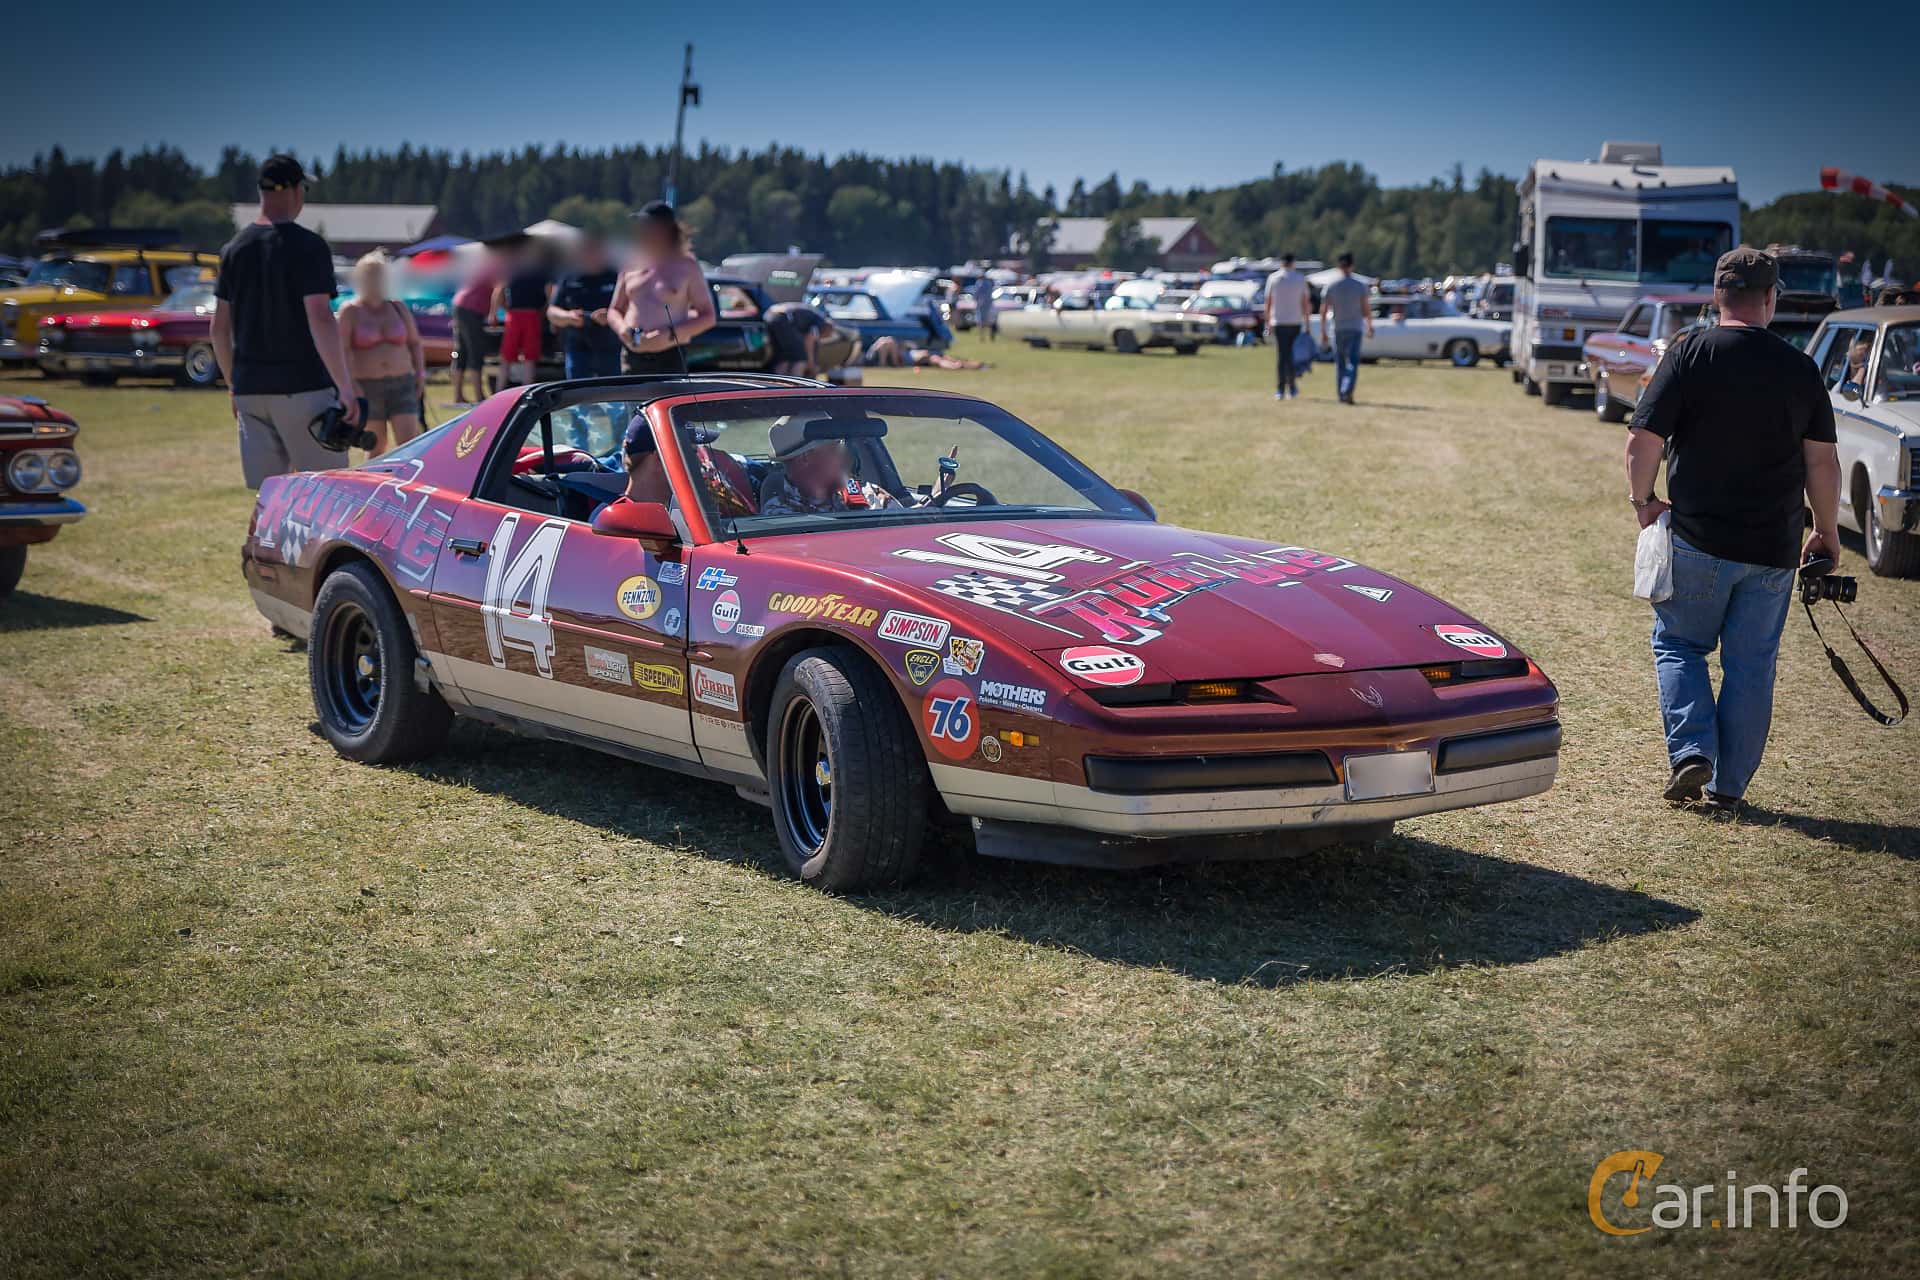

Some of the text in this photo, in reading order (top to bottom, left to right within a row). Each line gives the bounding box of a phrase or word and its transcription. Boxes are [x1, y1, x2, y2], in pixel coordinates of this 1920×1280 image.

[891, 532, 1112, 583] 14
[481, 512, 571, 679] 14
[622, 588, 657, 604] PENNZOIL
[714, 604, 739, 620] Gulf
[768, 592, 879, 628] GOODYEAR
[884, 615, 943, 644] SIMPSON
[1444, 634, 1498, 647] Gulf
[908, 654, 936, 665] ENGLE
[1067, 657, 1137, 672] Gulf
[592, 669, 622, 680] POLE
[643, 667, 681, 690] SPEEDWAY
[695, 669, 735, 697] CURRIE
[980, 680, 1046, 705] MOTHERS
[927, 697, 973, 743] 76
